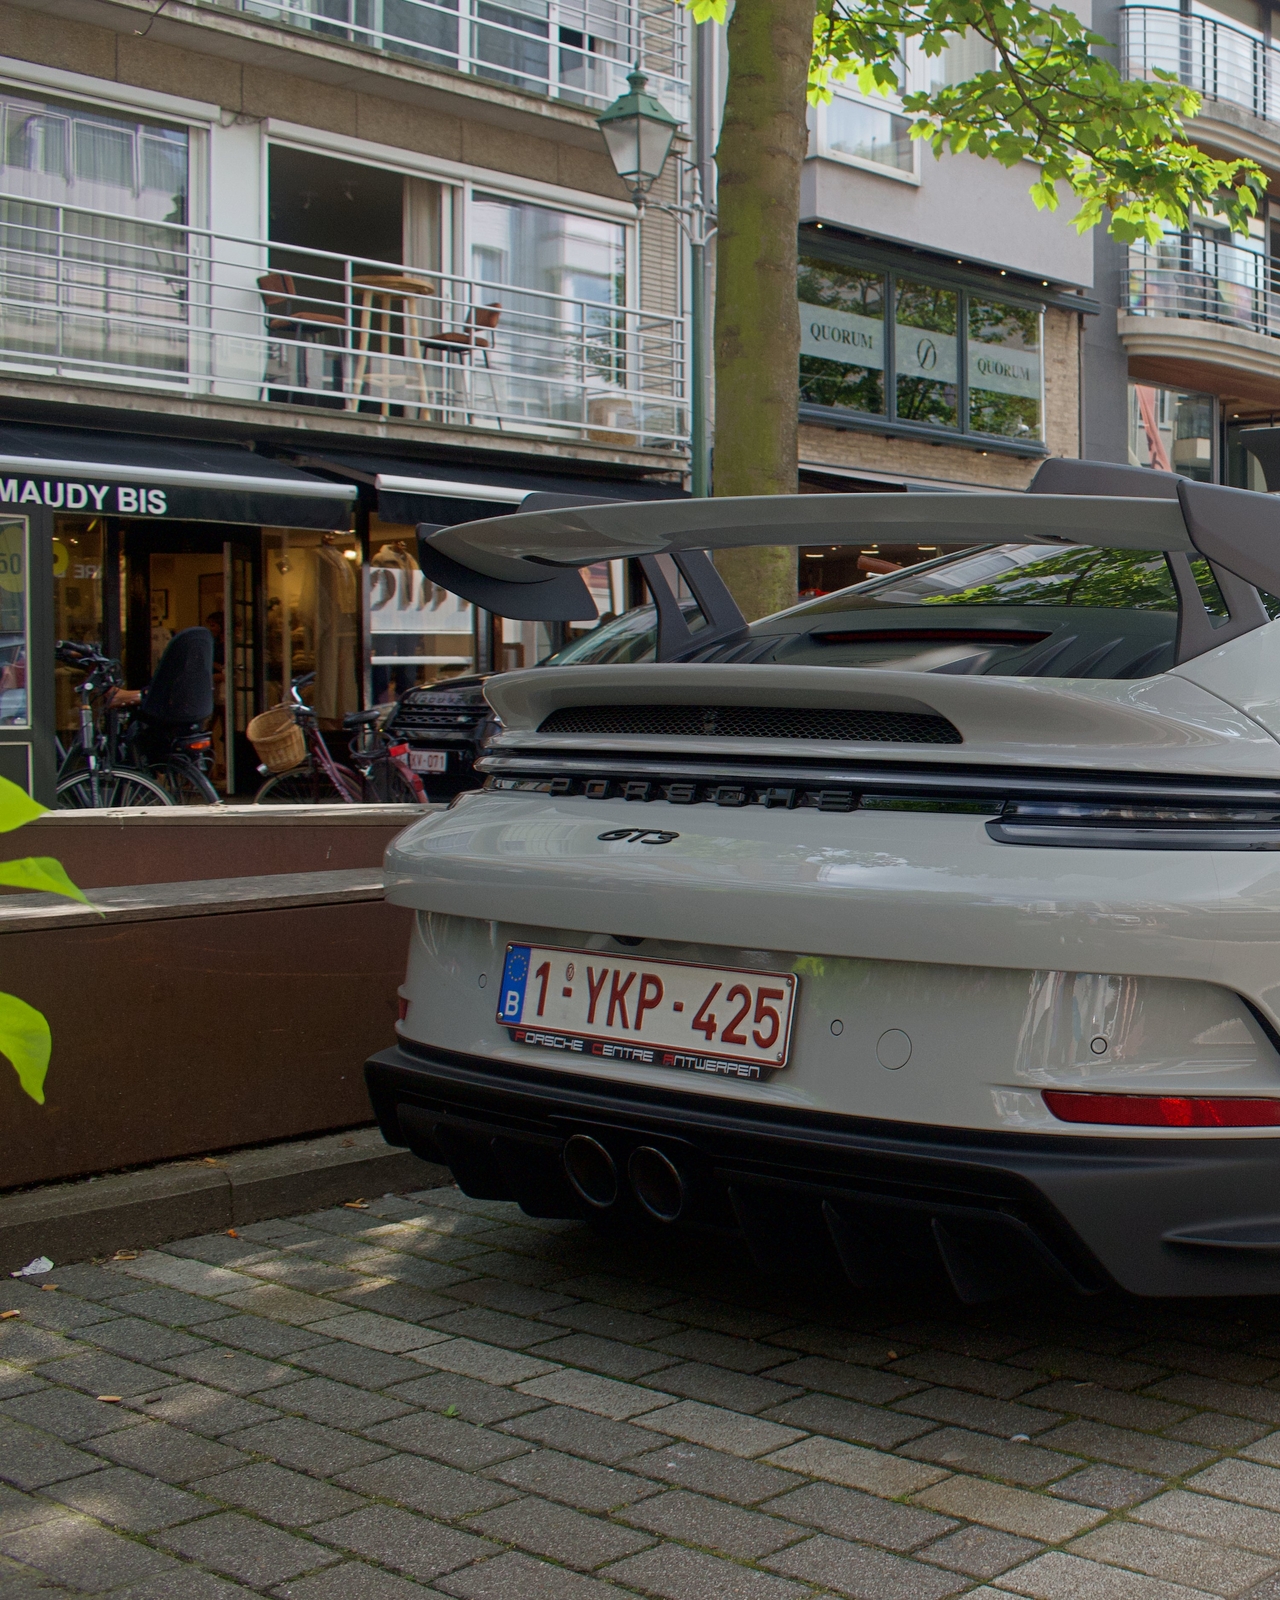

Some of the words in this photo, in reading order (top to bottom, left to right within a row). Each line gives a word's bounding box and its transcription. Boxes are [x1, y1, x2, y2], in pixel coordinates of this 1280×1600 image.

[810, 323, 873, 349] QUORUM
[977, 358, 1030, 381] QUORUM
[0, 478, 110, 510] MAUDY
[117, 486, 168, 515] BIS
[548, 777, 858, 812] PORSCHE
[597, 827, 680, 845] GT3
[504, 989, 521, 1017] B
[535, 961, 785, 1049] 1-YKP-425
[514, 1031, 584, 1052] PORSCHE
[591, 1044, 654, 1063] CENTRE
[662, 1054, 760, 1079] ANTWERPEN
